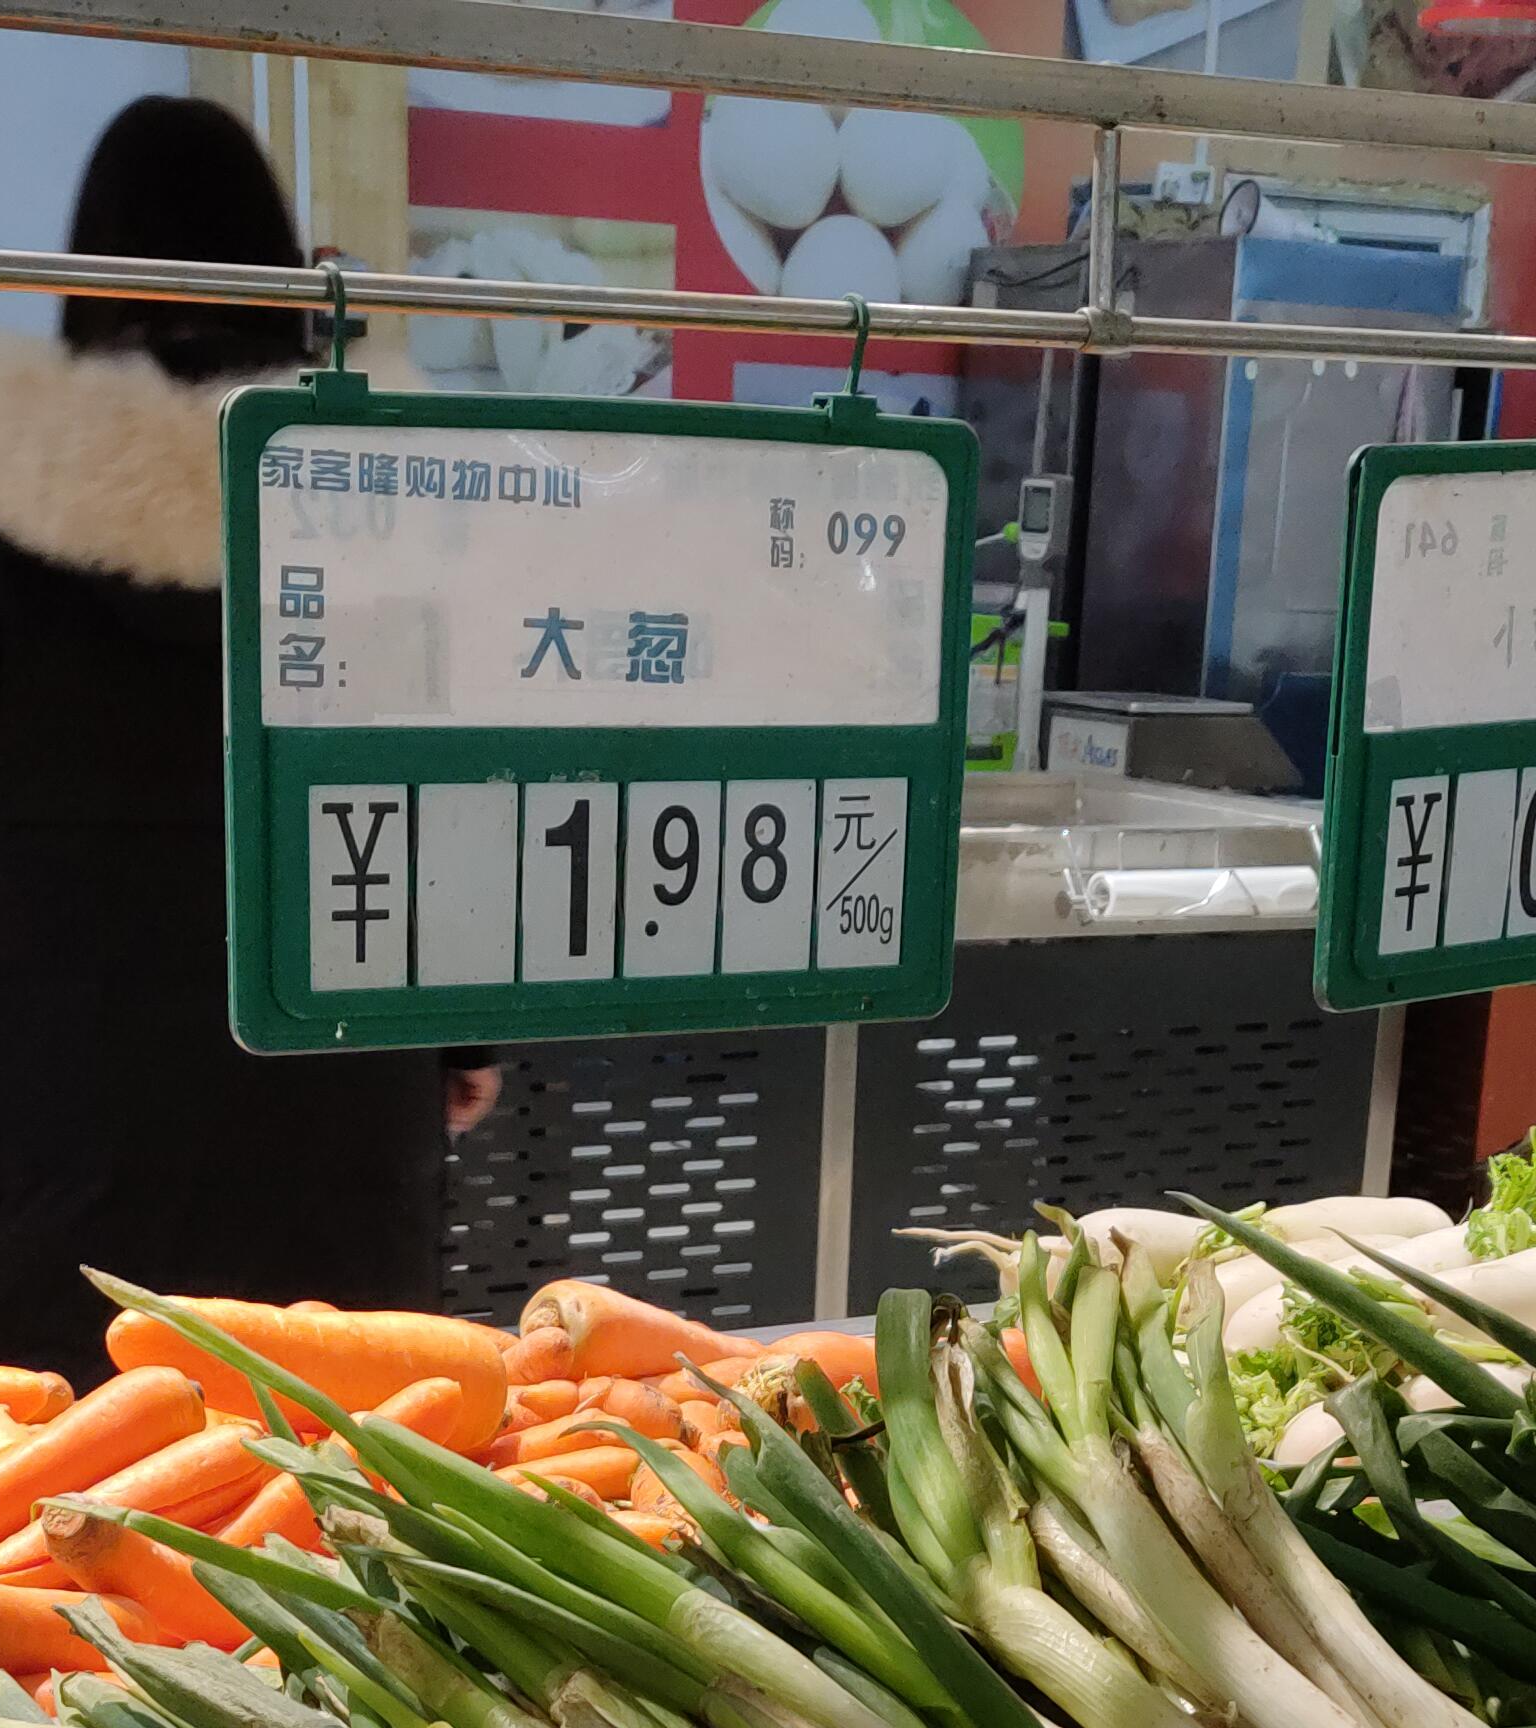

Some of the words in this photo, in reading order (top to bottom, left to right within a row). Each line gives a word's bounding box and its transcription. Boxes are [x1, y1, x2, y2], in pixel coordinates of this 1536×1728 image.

[827, 511, 907, 558] 099
[520, 607, 690, 685] 大葱
[321, 802, 399, 964] ¥
[1393, 793, 1442, 932] ¥
